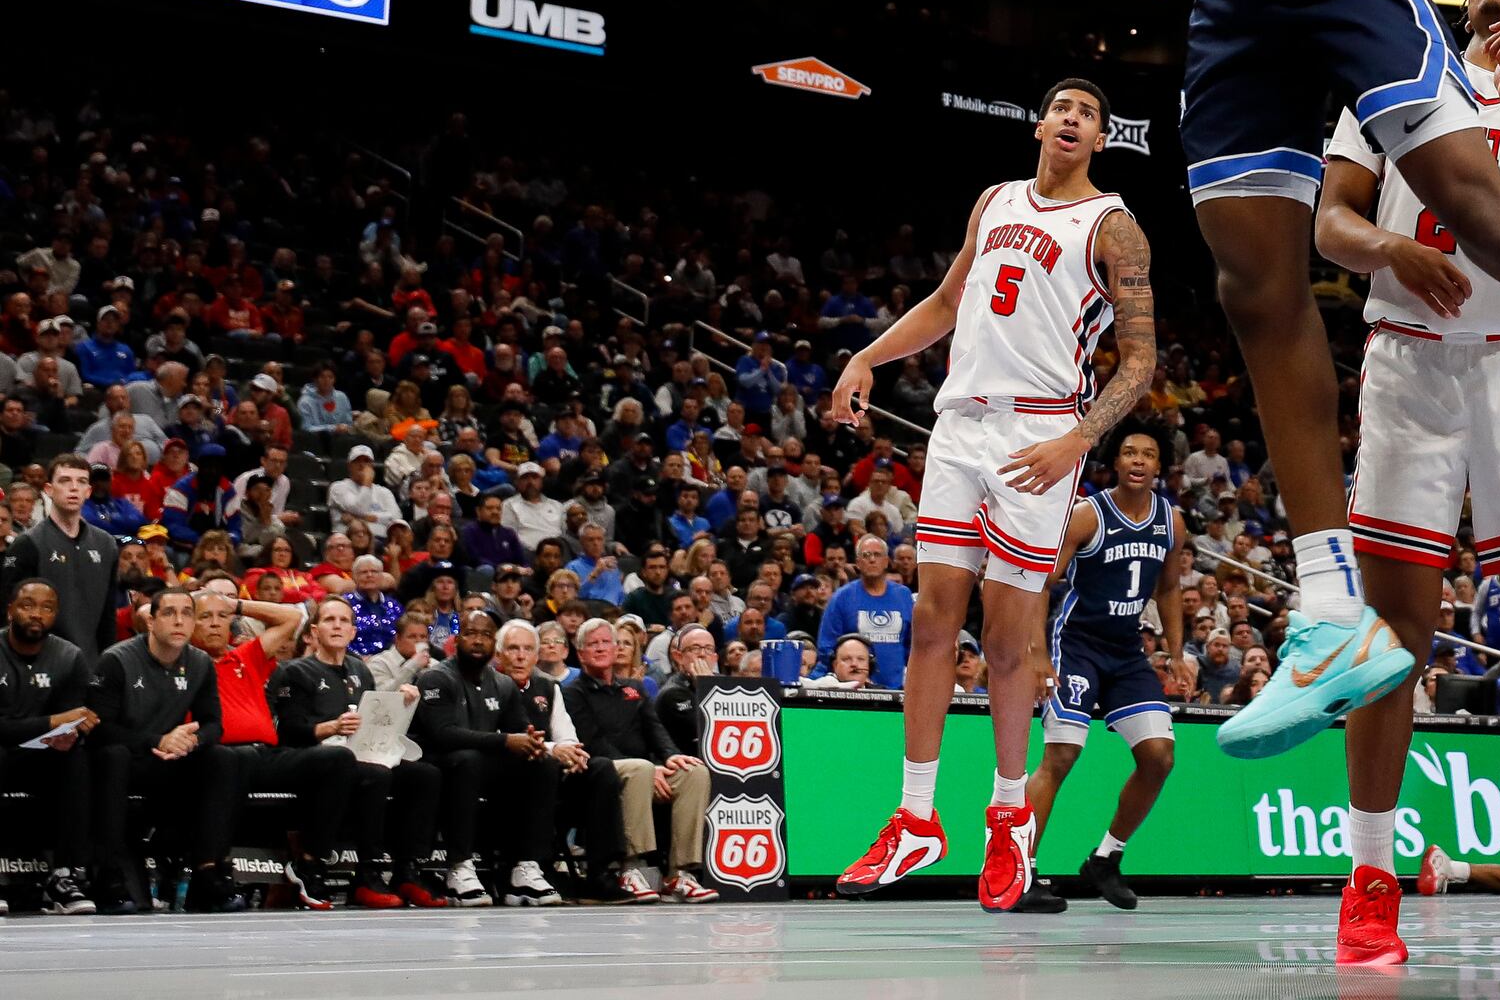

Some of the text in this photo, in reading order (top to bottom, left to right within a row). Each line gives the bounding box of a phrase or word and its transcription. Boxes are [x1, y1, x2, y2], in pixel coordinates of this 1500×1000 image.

[777, 66, 845, 91] SERVPRO
[981, 223, 1063, 275] HOUSTON
[990, 263, 1026, 318] 5
[1104, 542, 1167, 563] BRIGHAM
[1126, 560, 1142, 598] 1
[714, 701, 767, 717] PHILLIPS
[717, 725, 765, 759] 66
[718, 809, 772, 826] PHILLIPS
[1253, 788, 1426, 858] thas
[721, 834, 769, 868] 66
